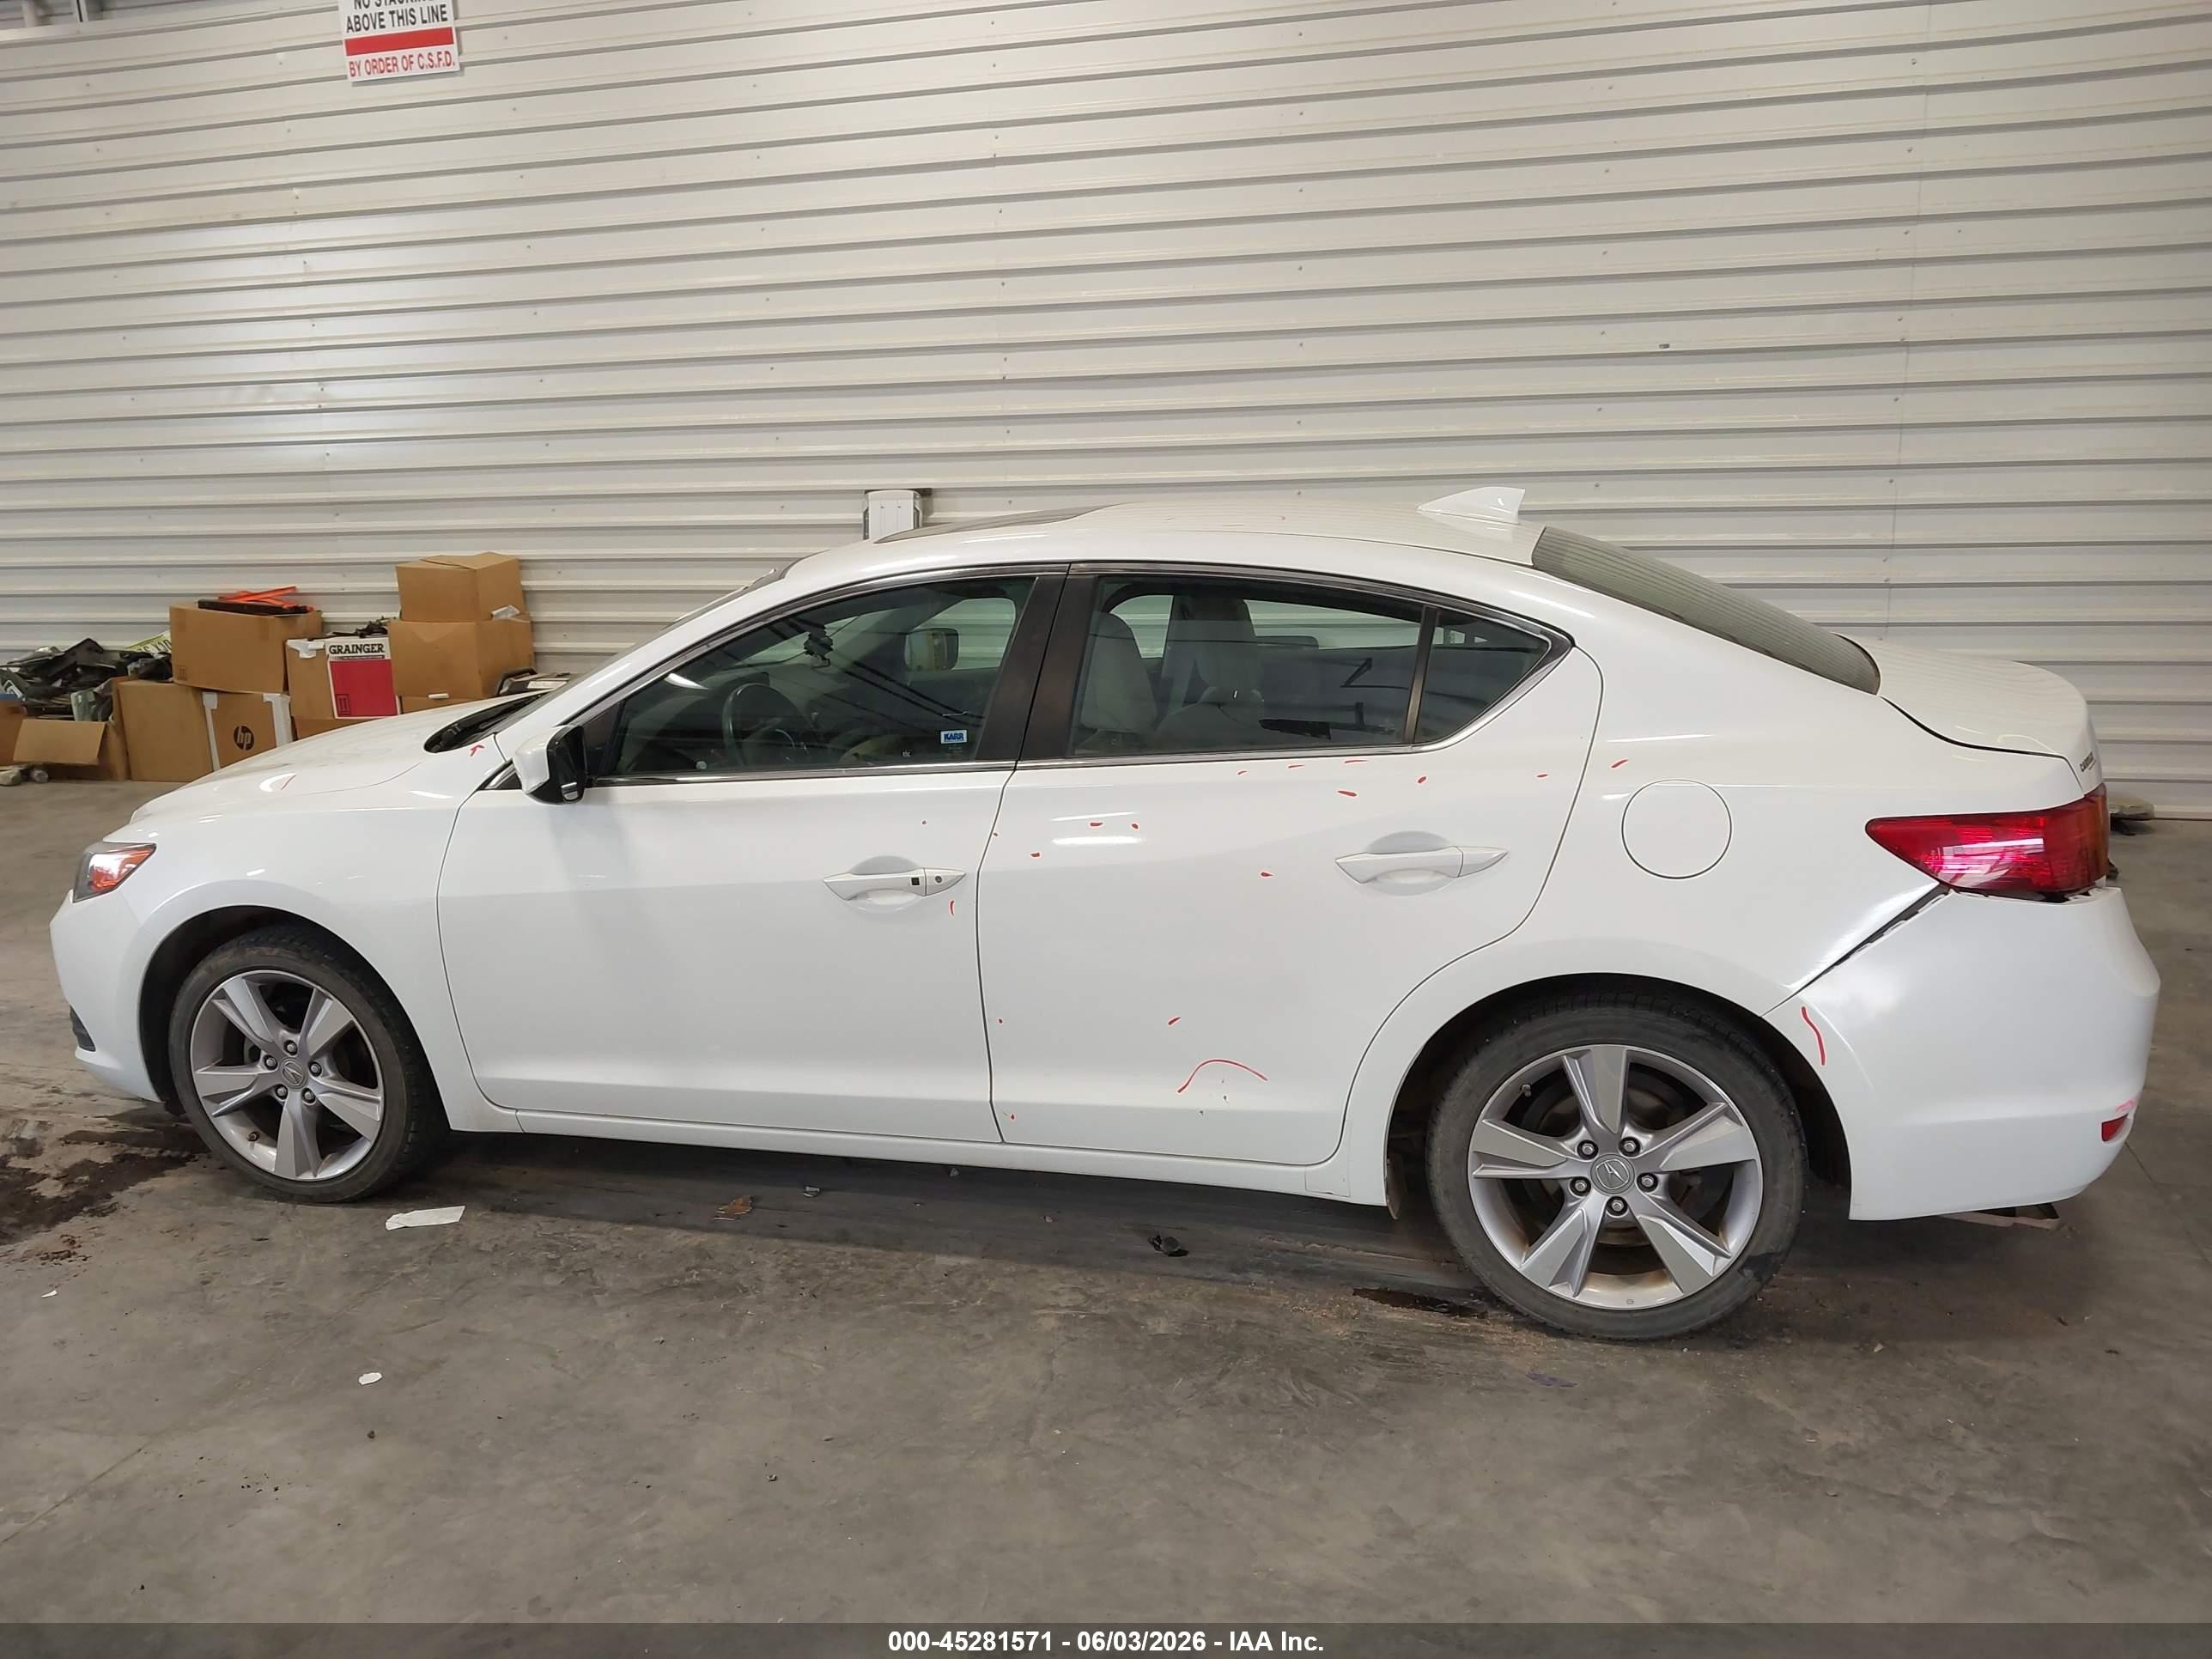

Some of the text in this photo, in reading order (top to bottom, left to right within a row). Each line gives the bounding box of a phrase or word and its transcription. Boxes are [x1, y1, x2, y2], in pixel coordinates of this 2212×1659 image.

[346, 4, 448, 33] ABOVE THIS LINE
[349, 50, 455, 77] BY ORDER OF C.S.F.D.
[329, 643, 385, 654] GRAINGER
[236, 726, 252, 751] hp
